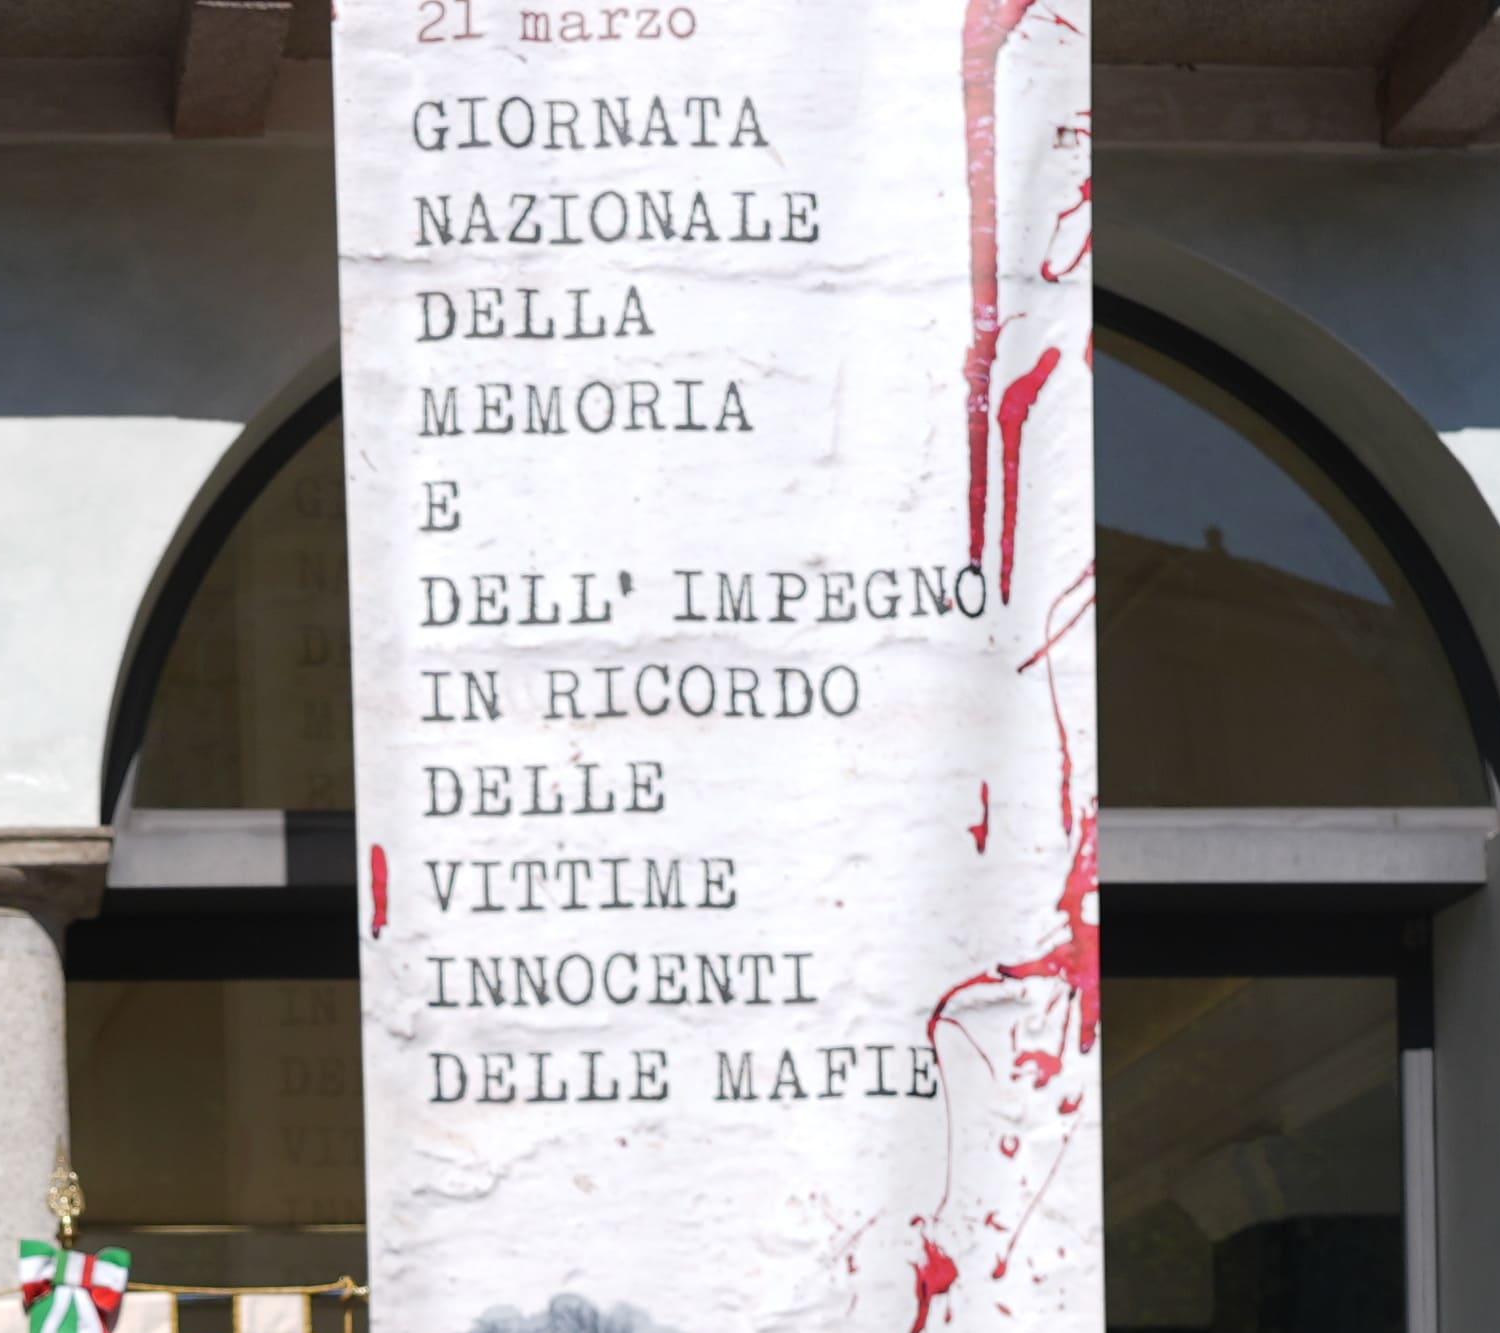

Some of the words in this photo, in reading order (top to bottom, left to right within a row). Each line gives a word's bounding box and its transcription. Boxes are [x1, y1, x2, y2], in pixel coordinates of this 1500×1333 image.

[521, 5, 698, 42] marzo
[414, 97, 767, 150] GIORNATA
[417, 192, 818, 245] NAZIONALE
[419, 288, 652, 341] DELLA
[421, 381, 752, 435] MEMORIA
[423, 482, 459, 530] E
[423, 572, 631, 625] DELL'
[676, 560, 986, 621] IMPEGNO
[424, 672, 499, 720] IN
[546, 665, 857, 718] RICORDO
[426, 763, 663, 816] DELLE
[428, 859, 735, 911] VITTIME
[429, 954, 815, 1007] INNOCENTI
[431, 1052, 667, 1103] DELLE
[717, 1038, 939, 1100] MAFIE
